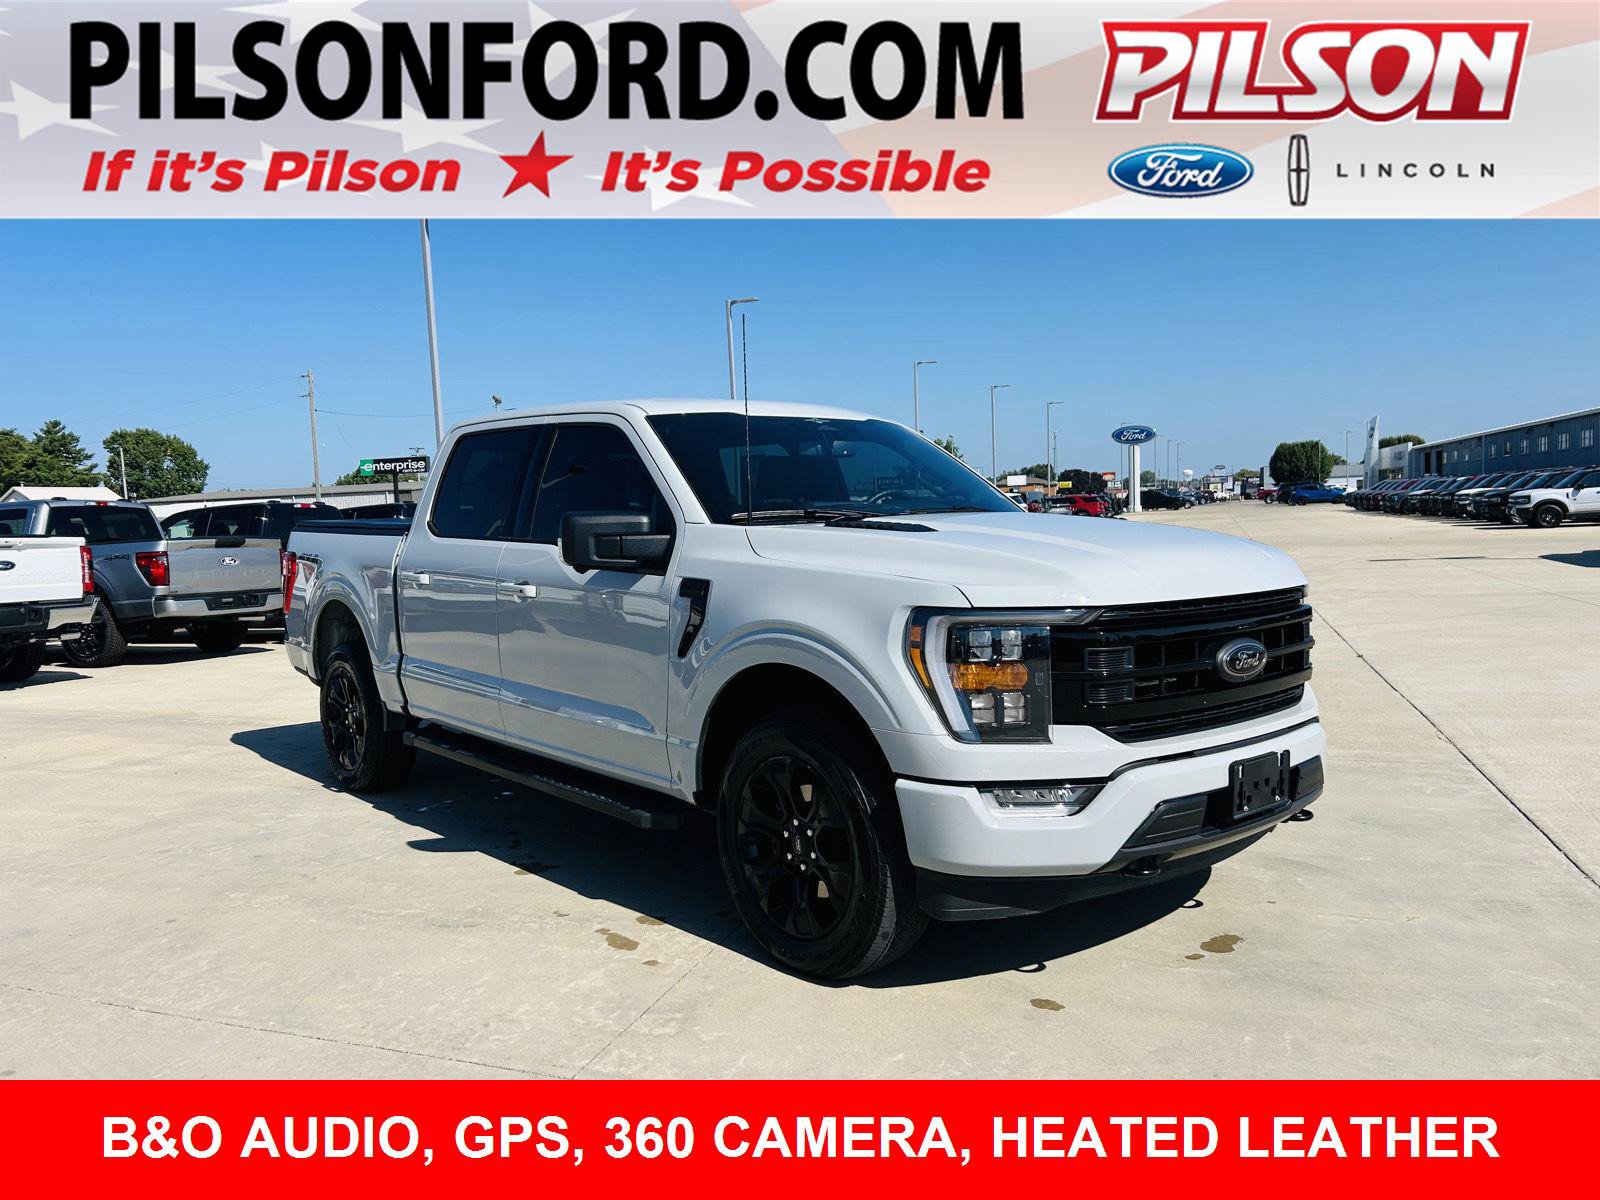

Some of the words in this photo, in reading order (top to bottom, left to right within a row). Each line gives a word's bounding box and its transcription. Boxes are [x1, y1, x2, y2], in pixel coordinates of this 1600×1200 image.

[1120, 429, 1147, 440] Ford
[363, 459, 426, 472] enterprise
[1235, 650, 1260, 669] Ford
